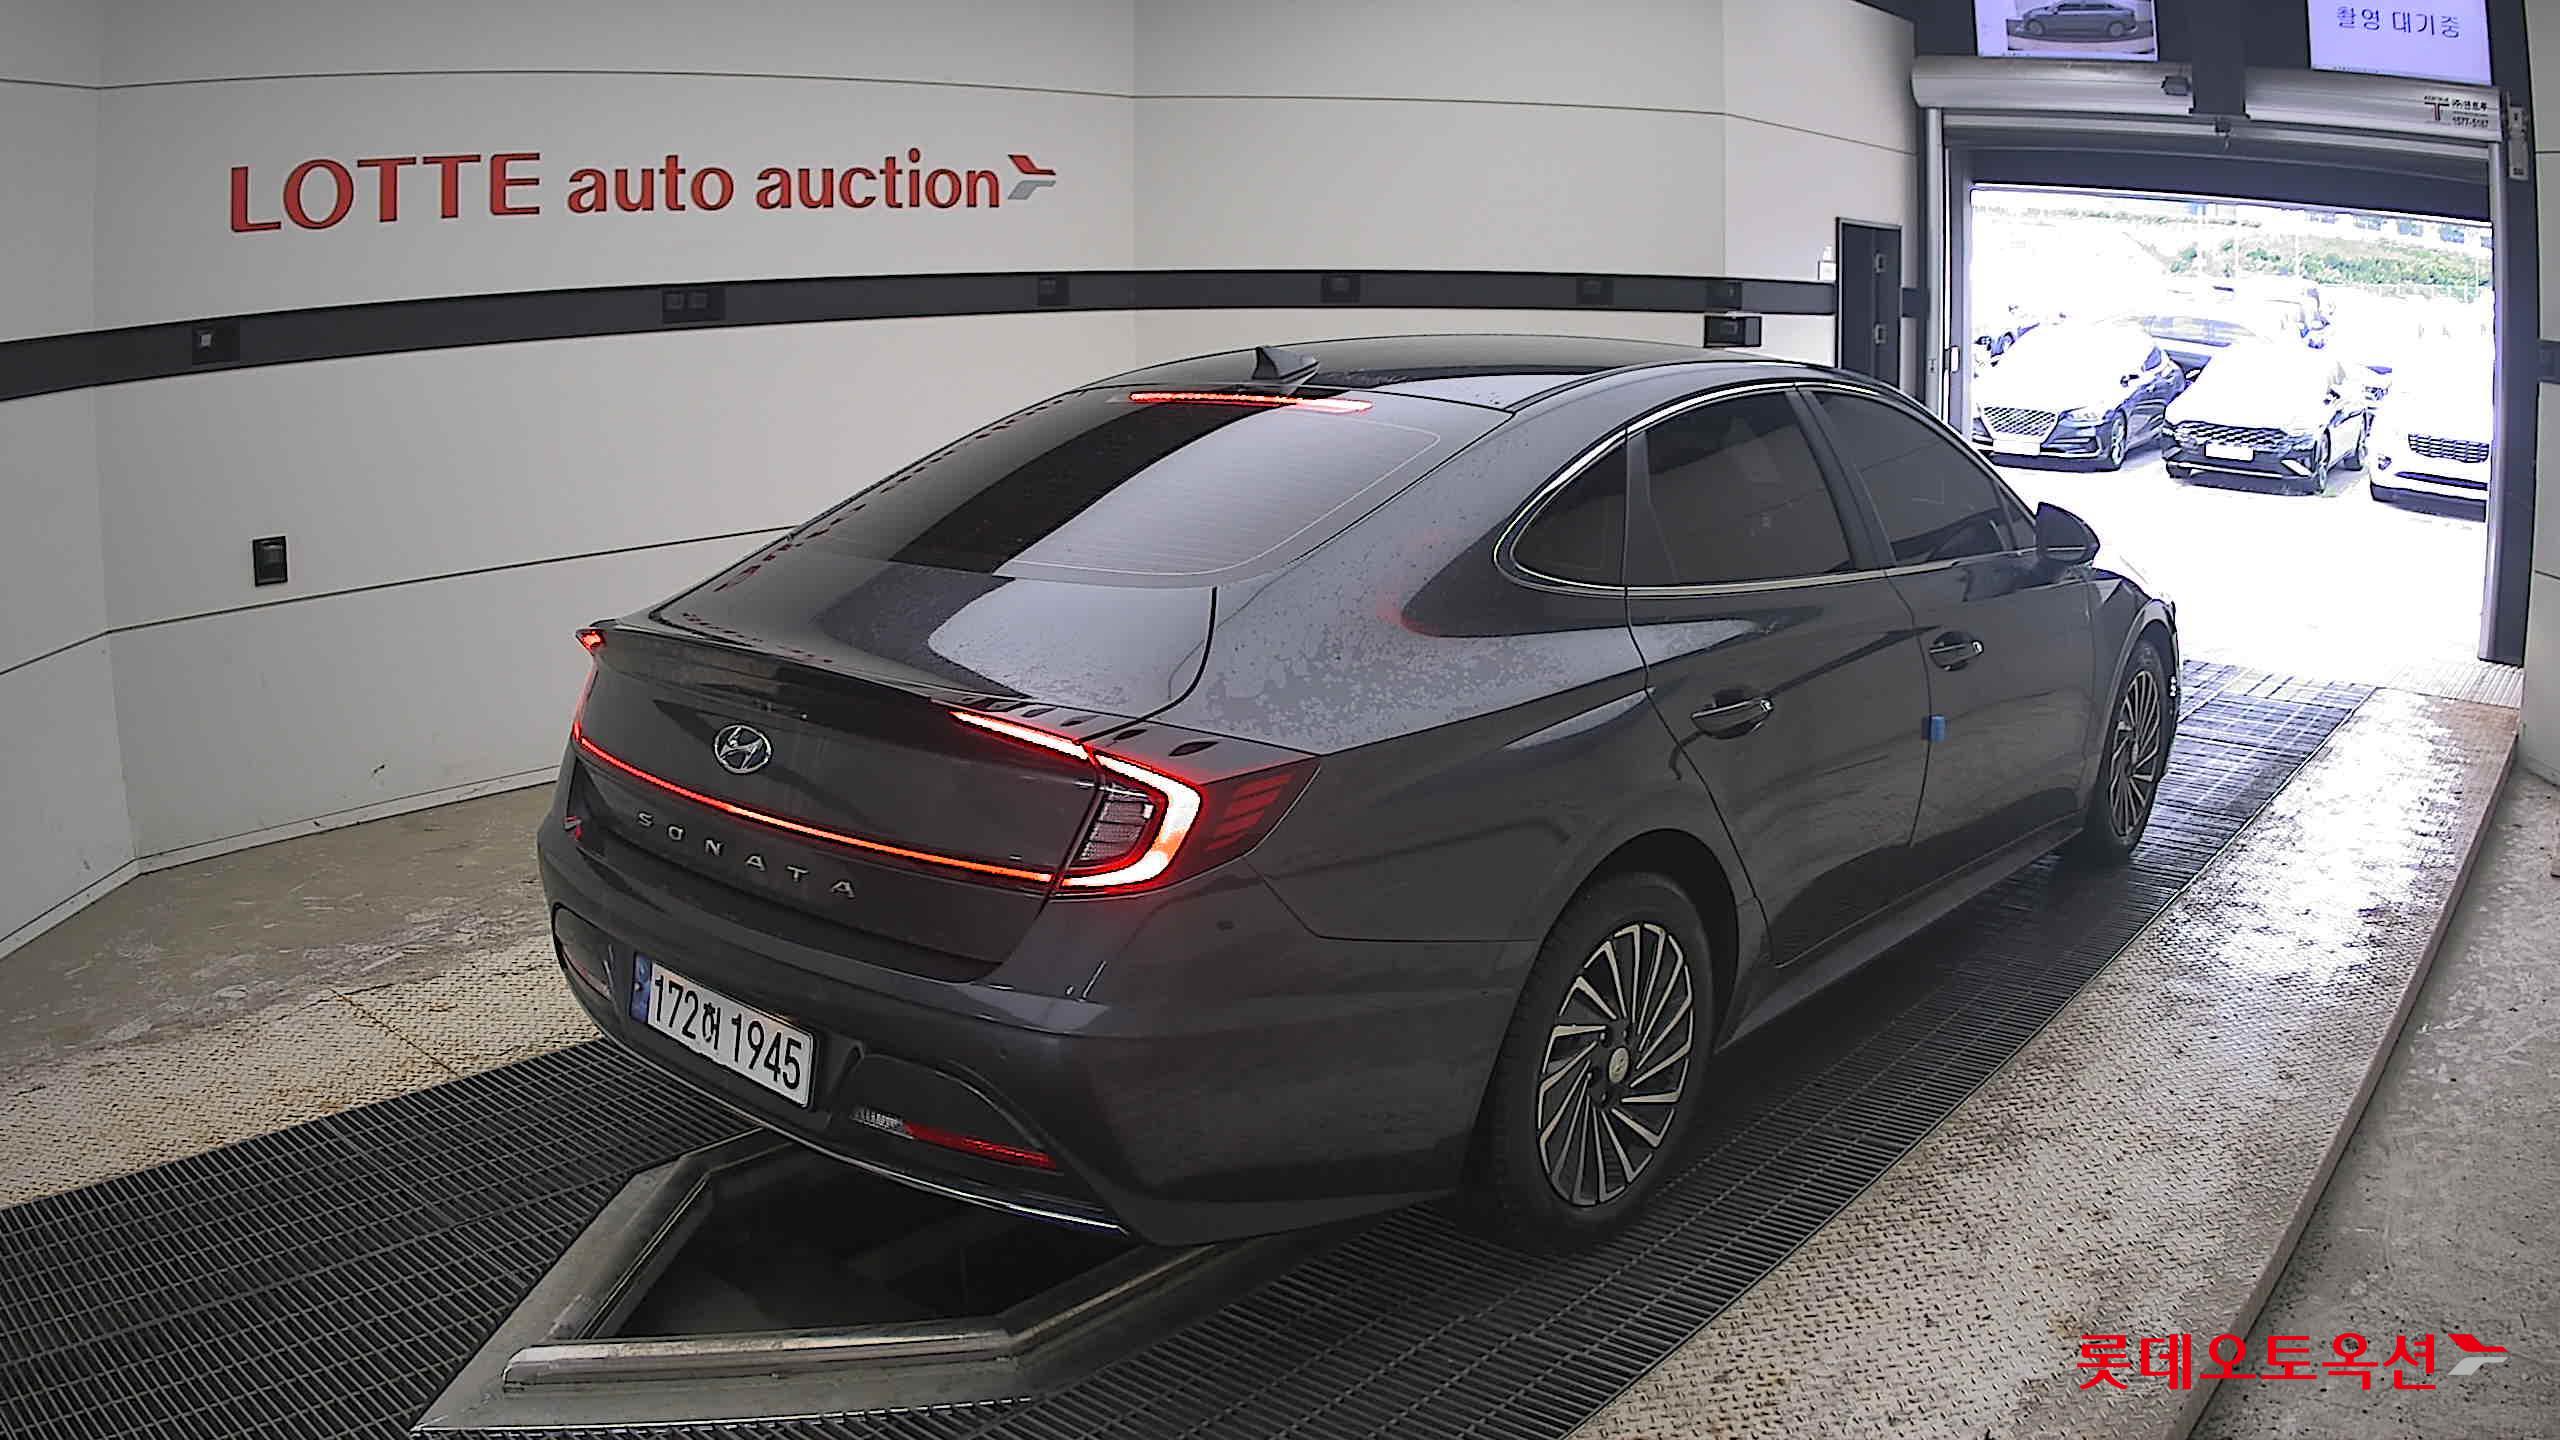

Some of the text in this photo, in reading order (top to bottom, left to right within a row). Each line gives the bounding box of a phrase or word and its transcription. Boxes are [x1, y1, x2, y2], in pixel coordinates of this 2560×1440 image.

[2337, 6, 2460, 38] 촬영 대기중
[230, 147, 1001, 234] LOTTE auto auction
[637, 812, 856, 899] SONATA
[732, 1013, 802, 1090] 1945
